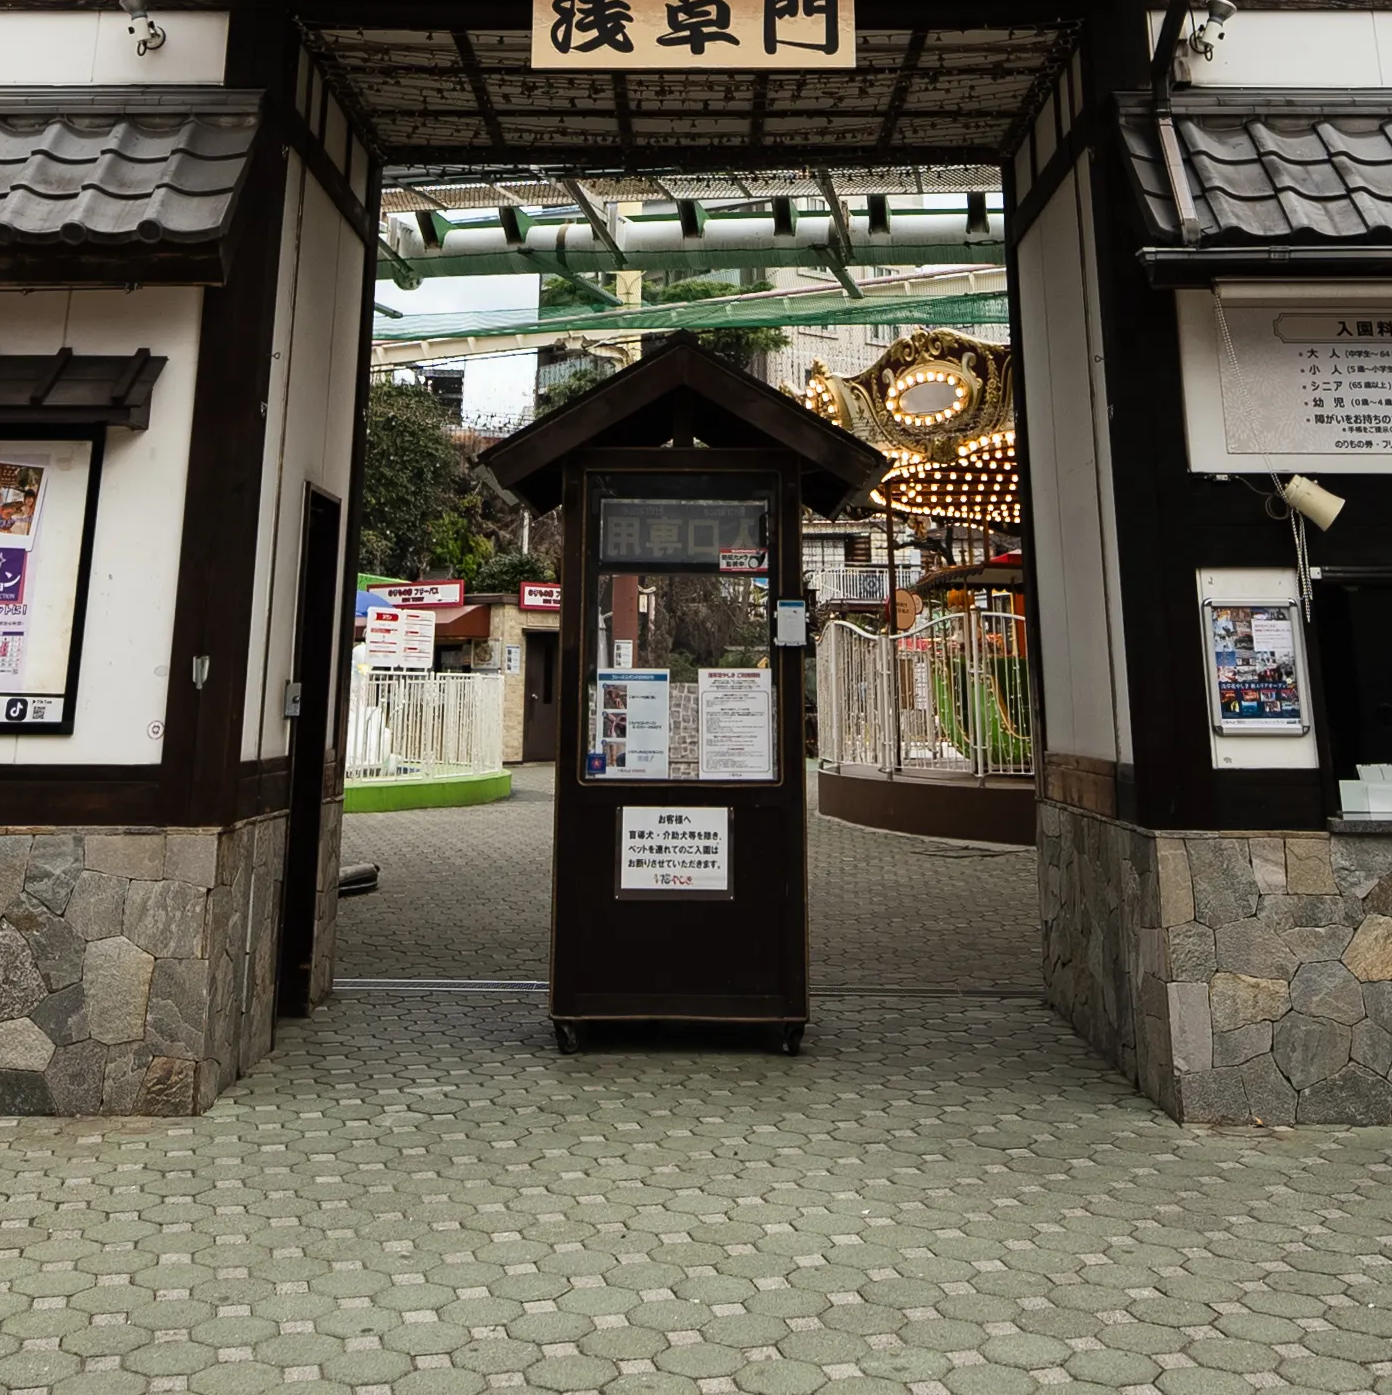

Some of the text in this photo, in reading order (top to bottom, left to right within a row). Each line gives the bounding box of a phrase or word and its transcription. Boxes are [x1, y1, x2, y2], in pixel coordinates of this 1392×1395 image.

[1310, 381, 1343, 392] シニア
[658, 814, 692, 825] お客様へ
[628, 845, 719, 855] ペットを連れてのご入園は
[627, 858, 721, 870] お断りさせていただきます。
